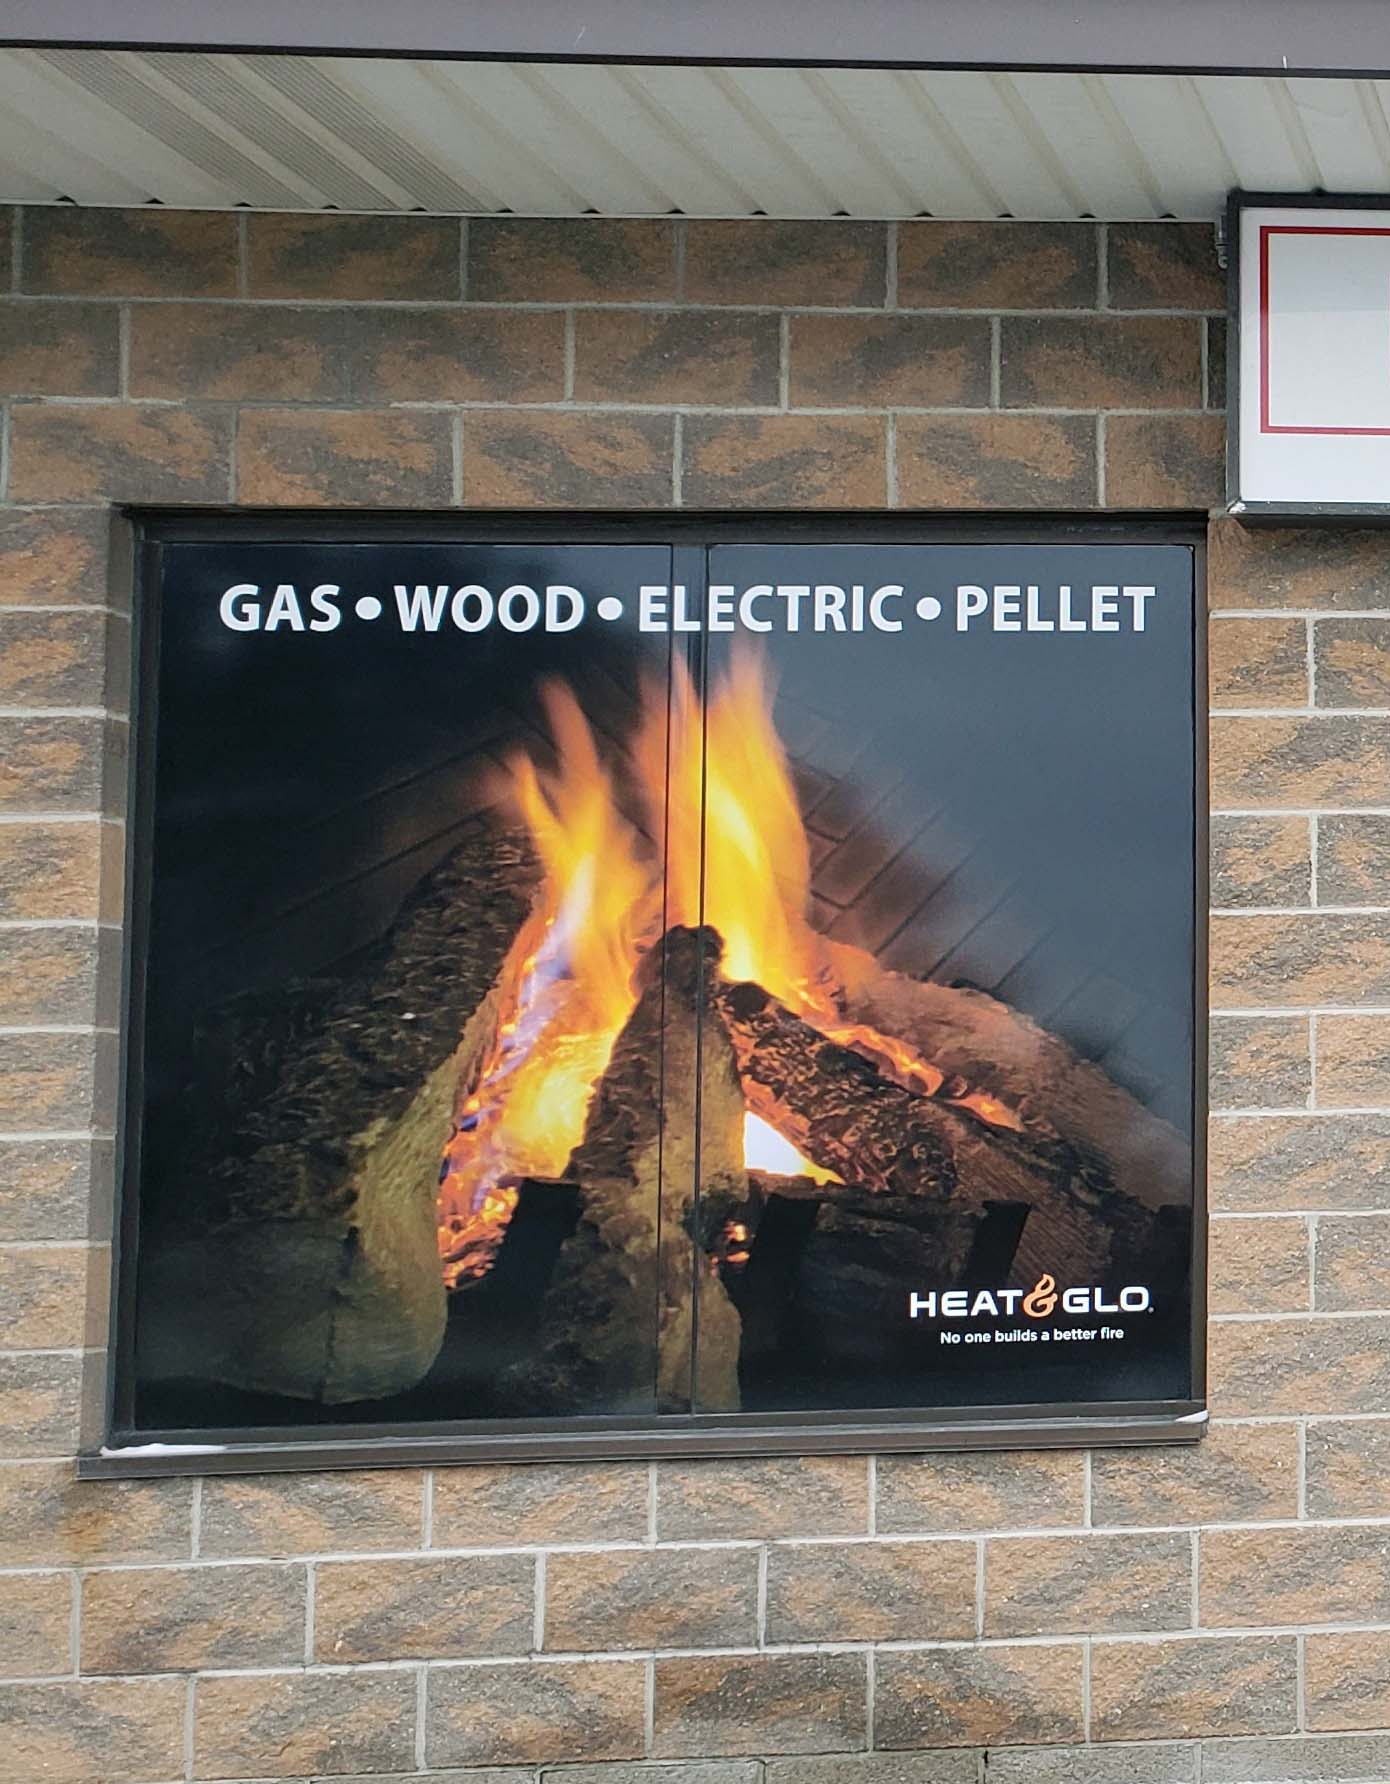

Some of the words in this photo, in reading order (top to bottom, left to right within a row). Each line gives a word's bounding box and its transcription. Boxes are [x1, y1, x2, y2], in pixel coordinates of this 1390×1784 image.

[218, 583, 342, 632] GAS
[392, 584, 585, 632] WOOD
[639, 584, 904, 632] ELECTRIC
[955, 585, 1156, 632] PELLET
[909, 1273, 1150, 1318] HEAT&GLO
[940, 1331, 961, 1345] No
[964, 1332, 992, 1343] one
[994, 1329, 1038, 1342] builds
[1040, 1331, 1050, 1341] a
[1053, 1328, 1098, 1341] better
[1100, 1326, 1125, 1340] fire
